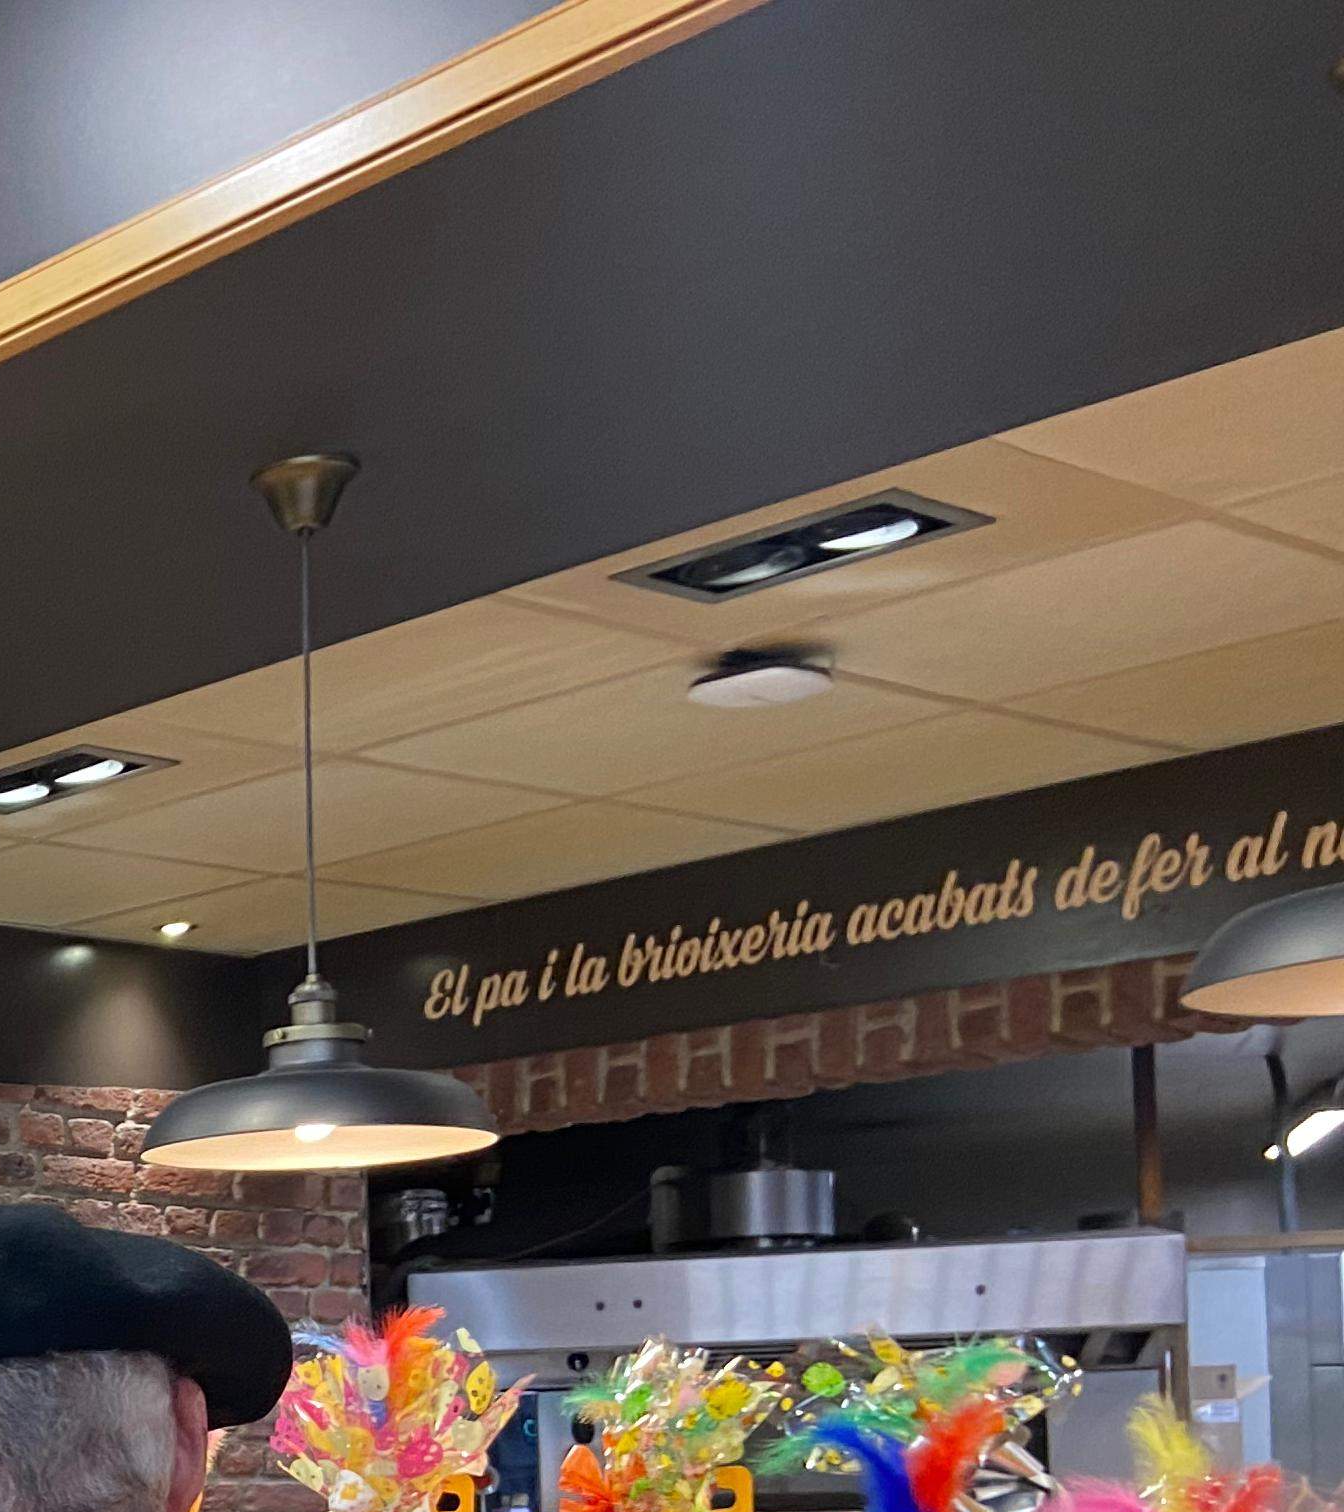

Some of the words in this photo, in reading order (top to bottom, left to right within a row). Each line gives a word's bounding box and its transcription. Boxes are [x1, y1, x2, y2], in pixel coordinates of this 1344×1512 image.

[424, 964, 470, 1020] El
[473, 967, 529, 1028] pa
[538, 949, 558, 1001] i
[565, 942, 611, 998] la
[618, 899, 837, 988] brioixeria
[846, 858, 1039, 946] acabats
[1055, 846, 1122, 912] de
[1120, 832, 1214, 921] fer
[1225, 810, 1289, 882] al
